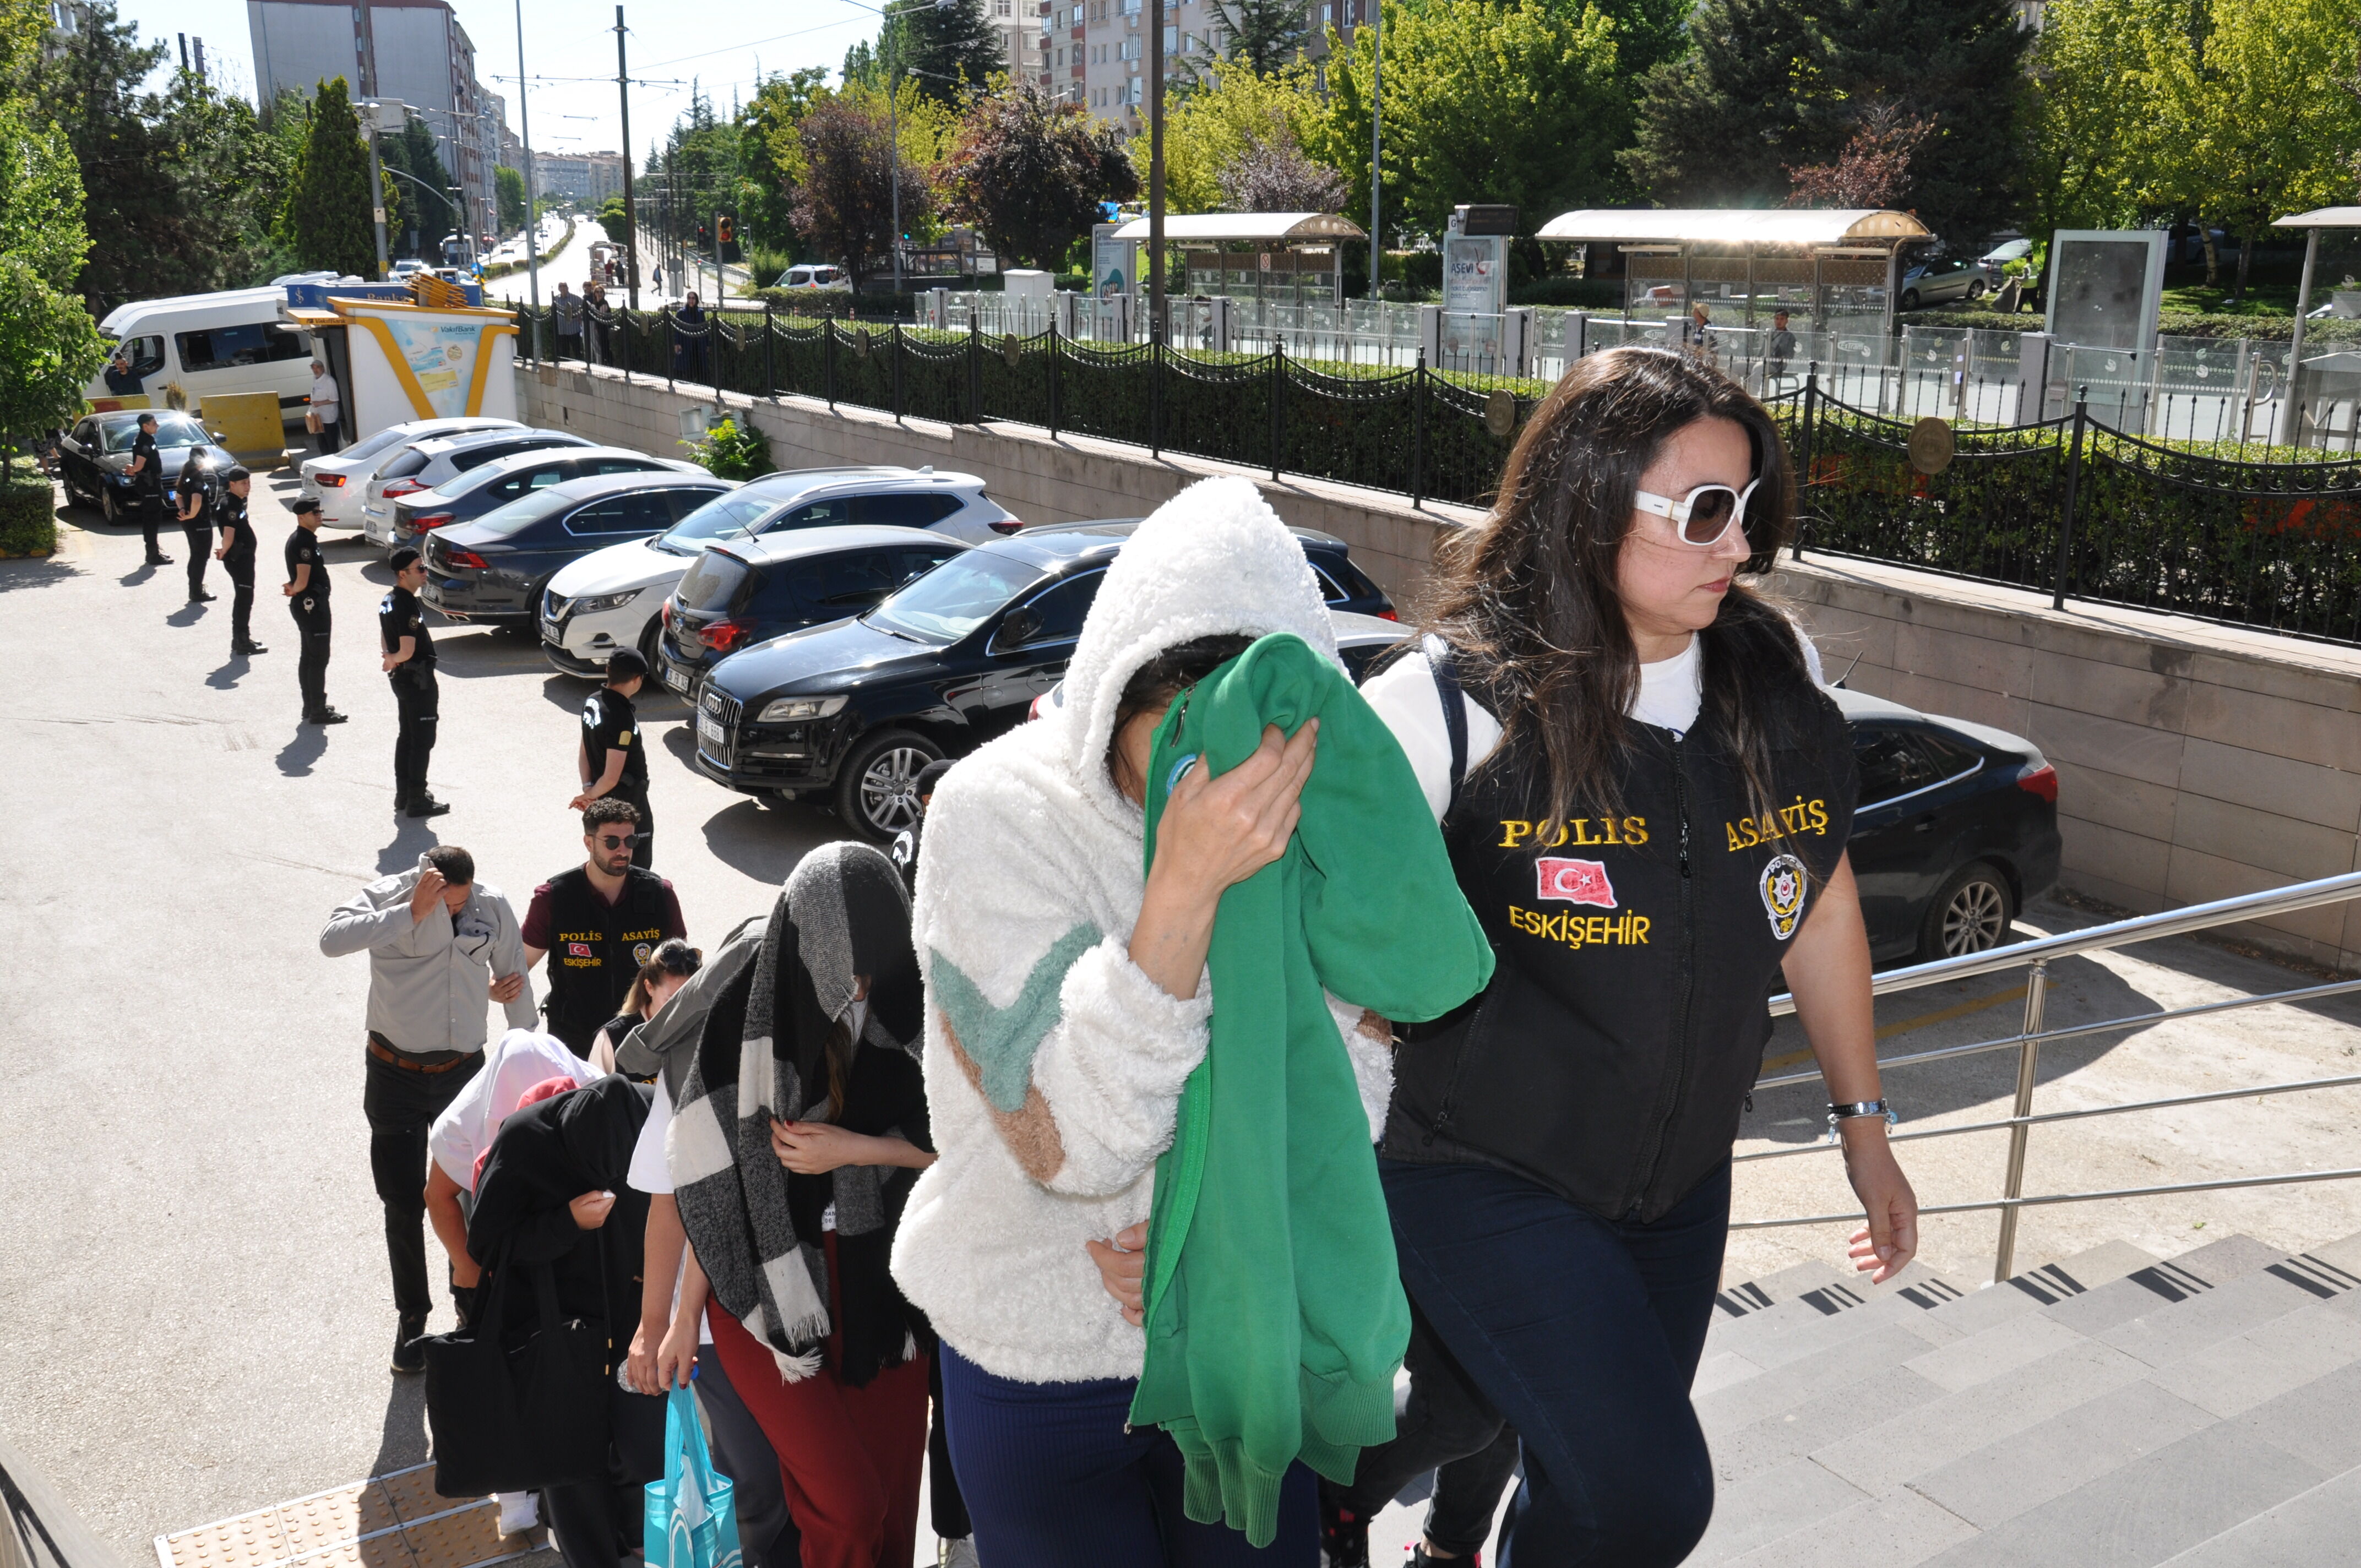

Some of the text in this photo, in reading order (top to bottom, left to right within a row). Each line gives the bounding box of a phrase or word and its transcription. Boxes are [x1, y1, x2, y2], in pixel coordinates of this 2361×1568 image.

[1498, 795, 1829, 852] POLİS ASAYİŞ
[559, 928, 660, 941] POLİS ASAYİŞ
[1509, 905, 1651, 950] ESKİŞEHİR
[564, 957, 602, 968] ESKİŞEHİR
